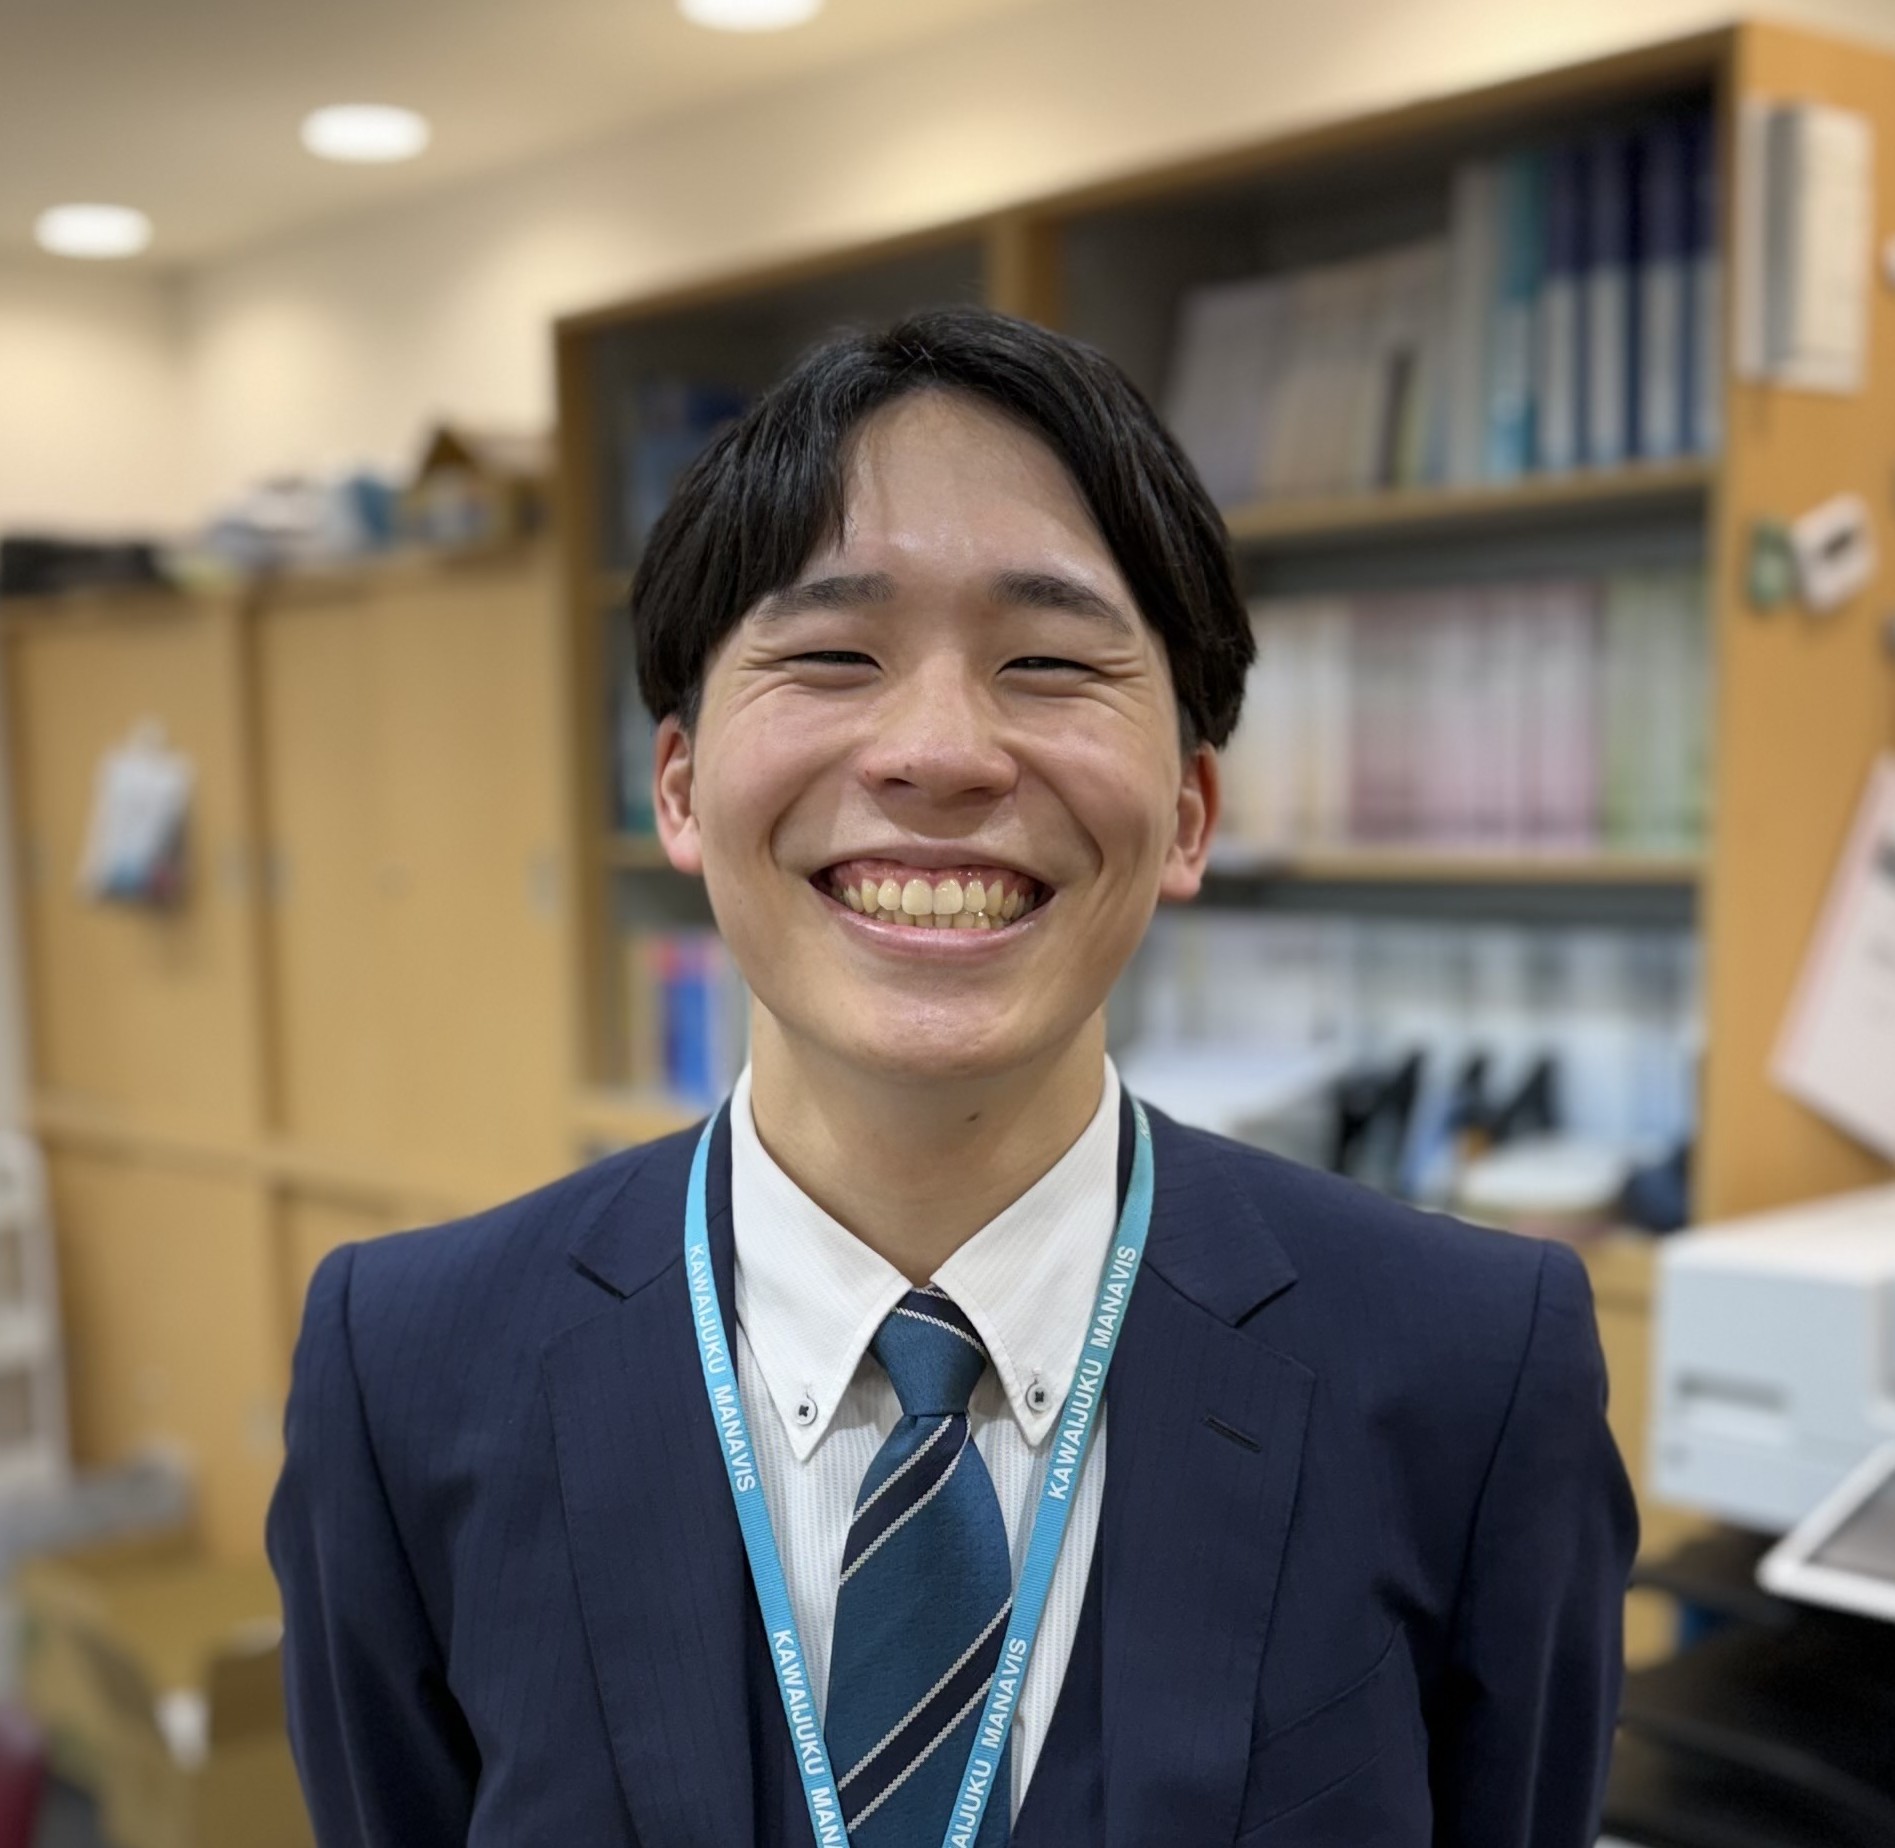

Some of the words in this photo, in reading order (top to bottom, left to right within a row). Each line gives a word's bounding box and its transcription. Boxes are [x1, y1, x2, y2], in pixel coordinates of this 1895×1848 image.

[689, 1244, 726, 1374] KAWAIJUKU
[713, 1384, 756, 1492] MANAVIS
[1048, 1359, 1103, 1500] KAWAIJUKU
[1091, 1245, 1137, 1349] MANAVIS
[773, 1629, 826, 1775] KAWAIJUKU
[811, 1786, 843, 1848] MAN
[981, 1637, 1027, 1749] MANAVIS
